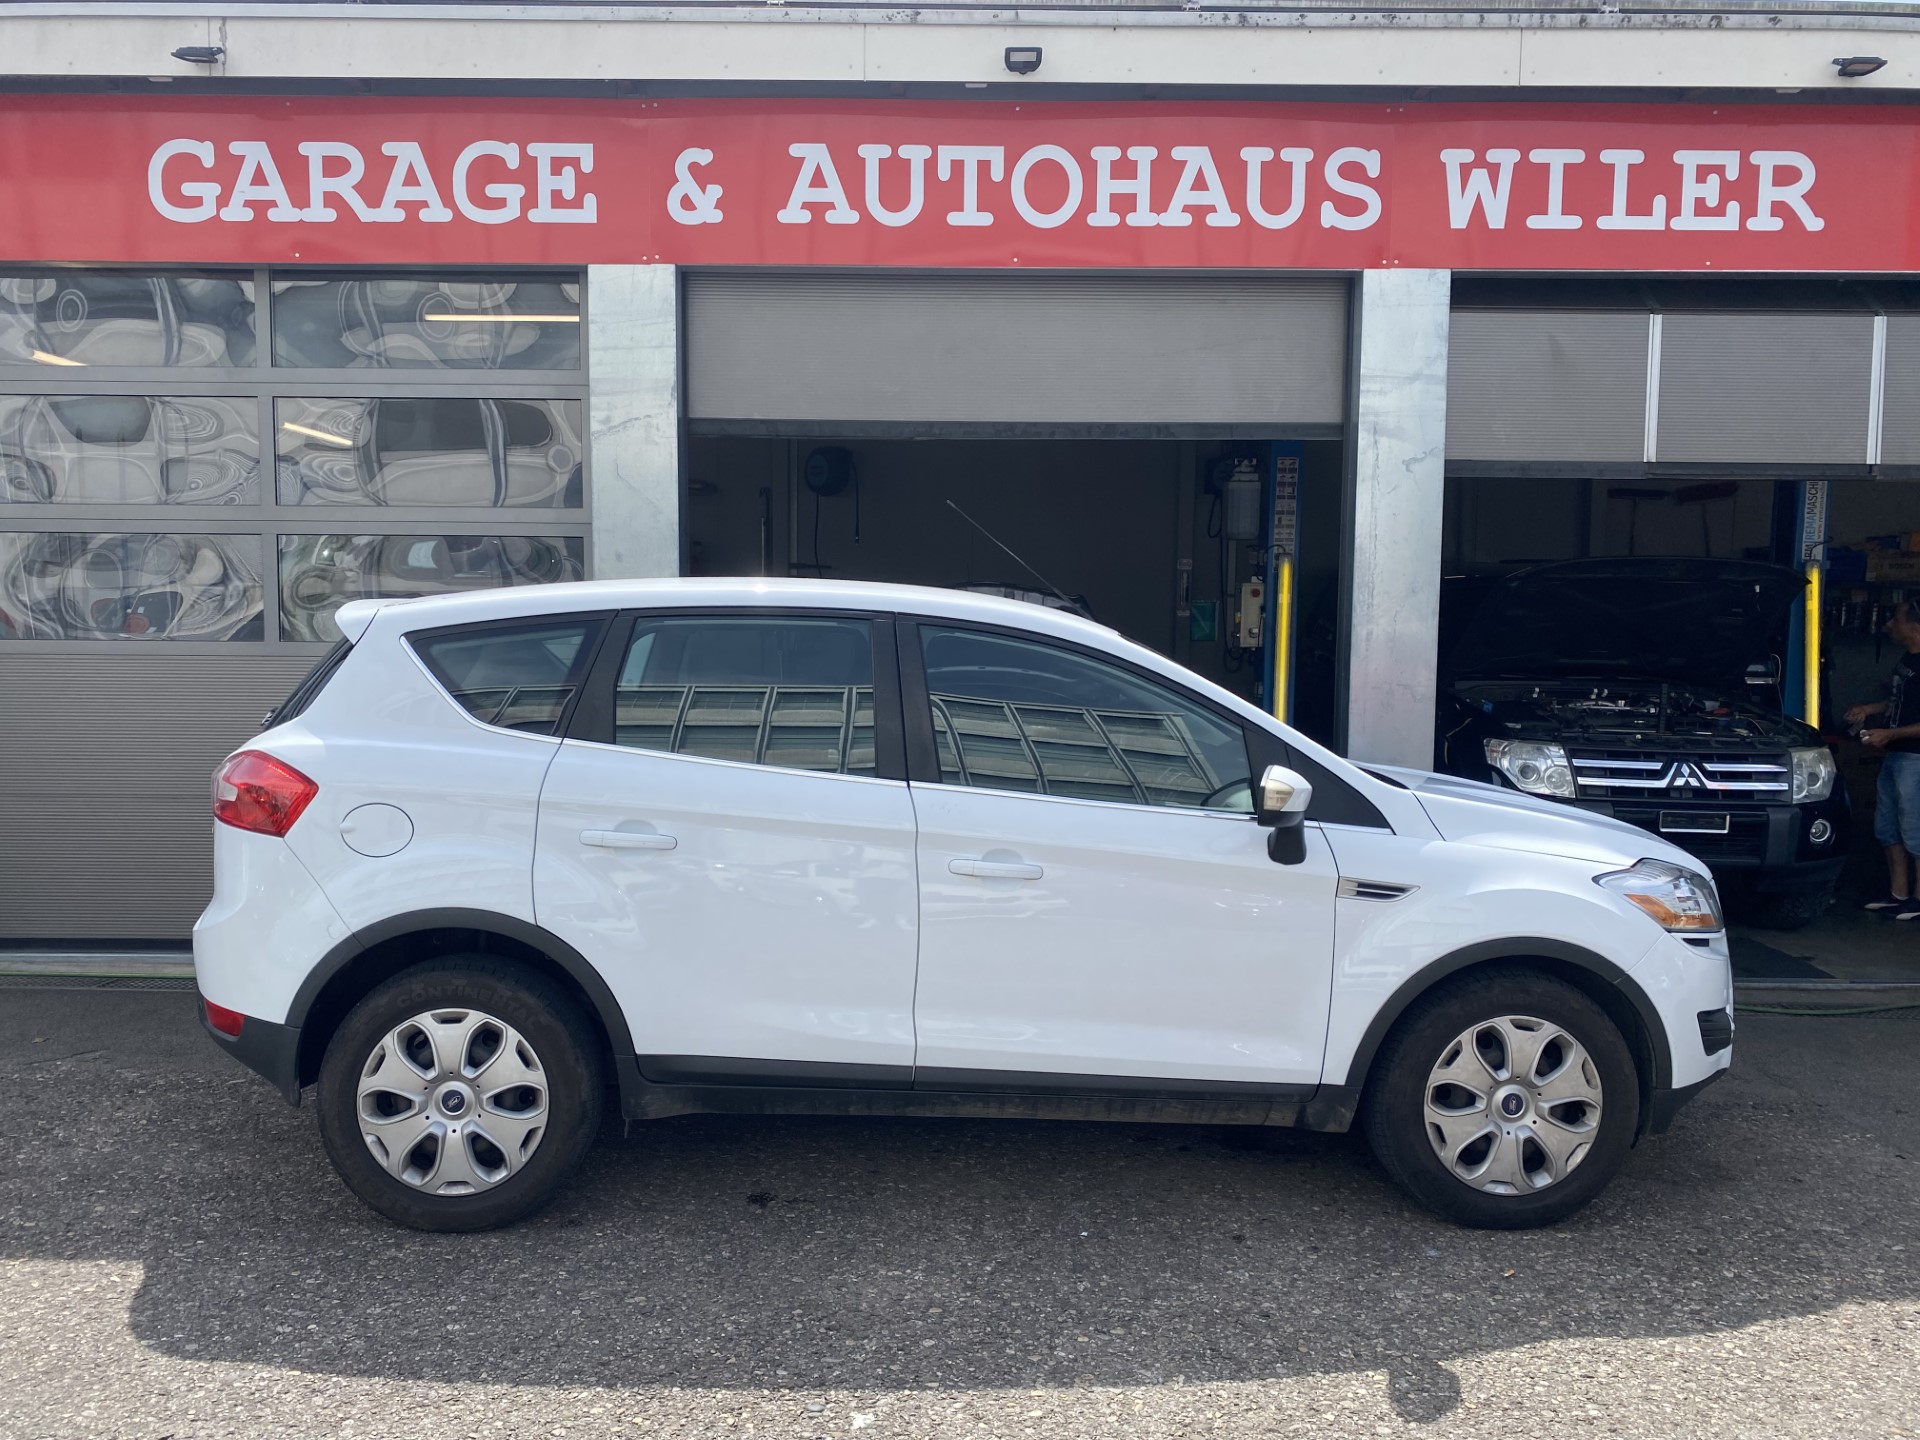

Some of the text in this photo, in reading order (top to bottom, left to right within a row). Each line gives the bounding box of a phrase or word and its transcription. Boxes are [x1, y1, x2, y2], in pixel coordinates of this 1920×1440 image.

[148, 138, 1825, 232] GARAGE & AUTOHAUS WILER
[396, 984, 540, 1030] CONTINENTAL
